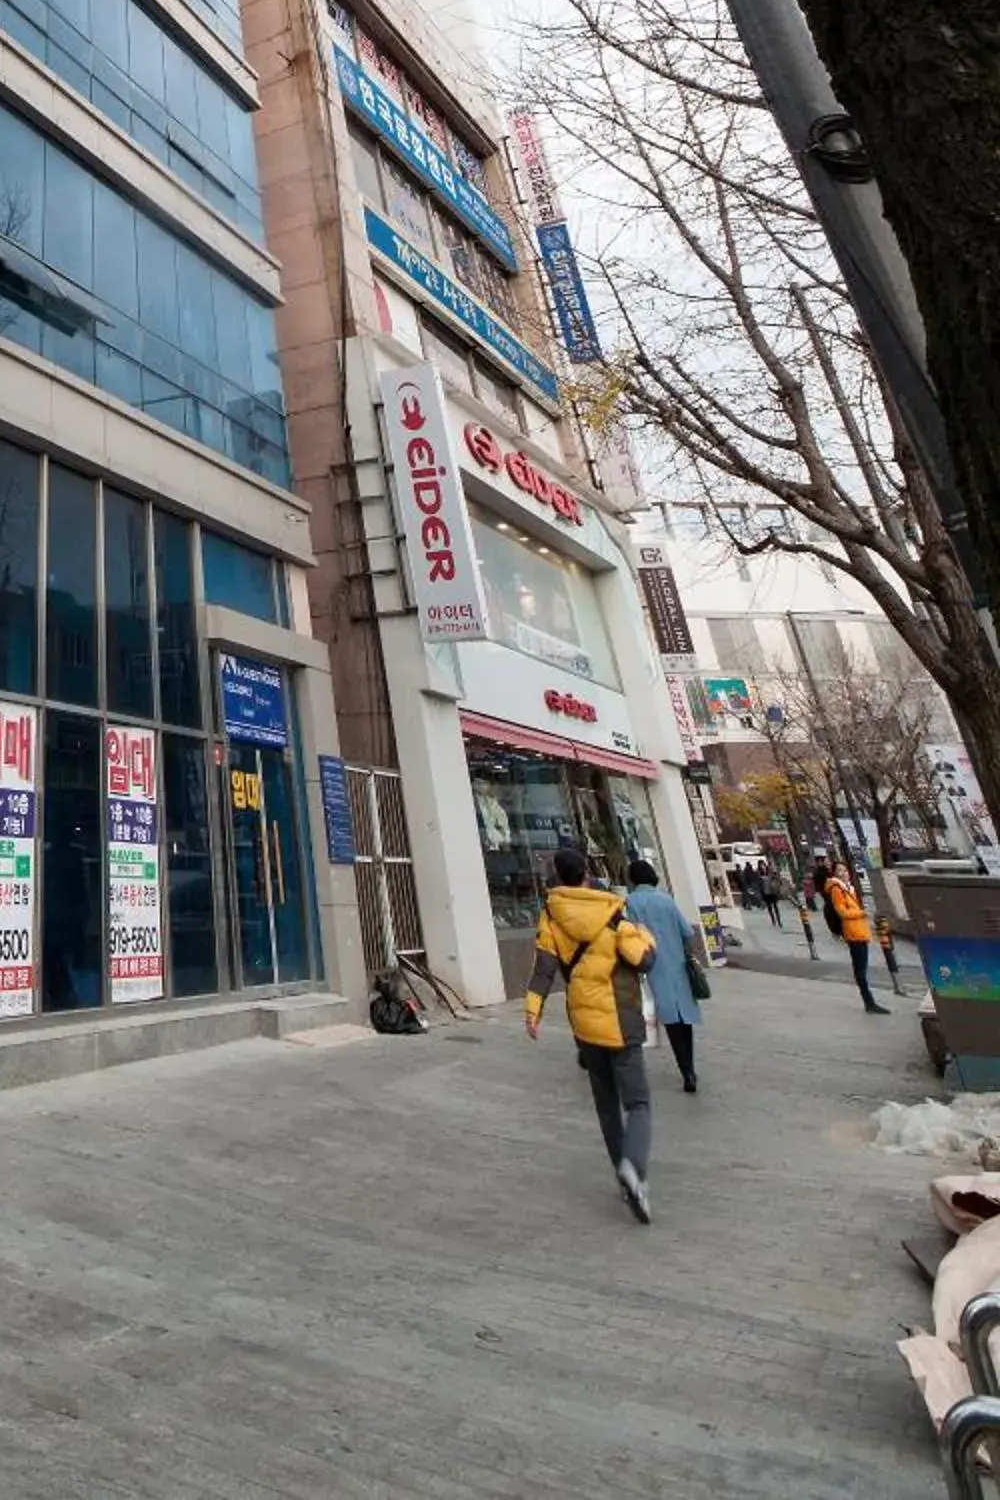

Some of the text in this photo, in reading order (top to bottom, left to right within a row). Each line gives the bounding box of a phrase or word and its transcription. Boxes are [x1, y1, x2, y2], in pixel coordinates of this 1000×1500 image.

[427, 603, 474, 621] 아이더
[106, 730, 155, 799] 임대
[231, 770, 261, 811] 임대
[108, 849, 143, 861] NAVER
